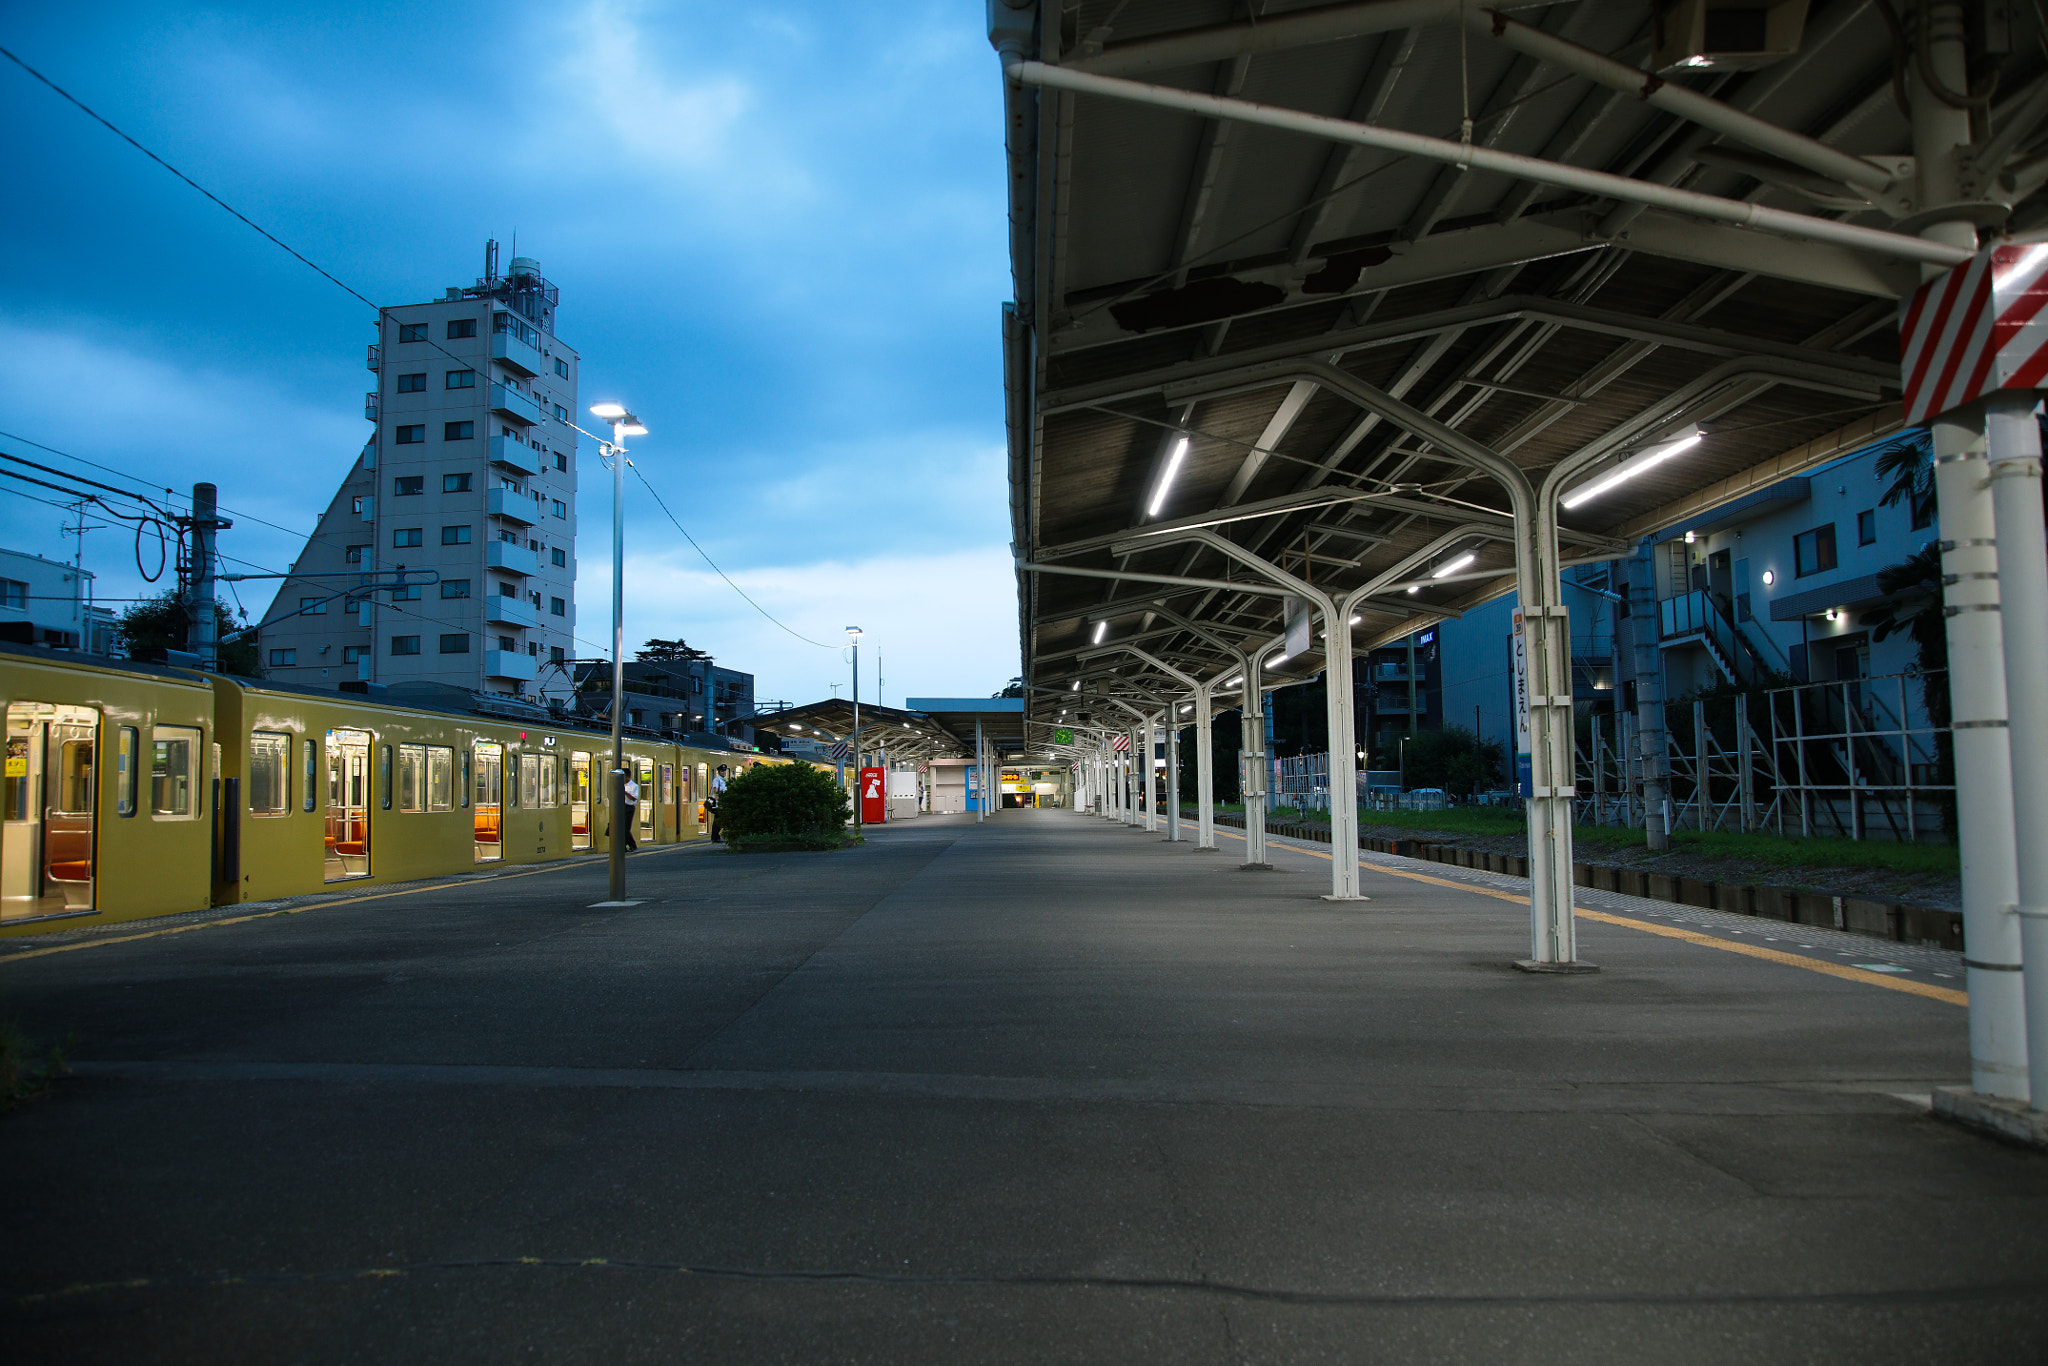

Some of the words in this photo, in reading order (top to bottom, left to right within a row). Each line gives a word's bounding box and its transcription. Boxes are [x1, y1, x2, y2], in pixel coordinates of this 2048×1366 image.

[1420, 632, 1434, 645] IMAX
[1516, 640, 1528, 733] としまえん
